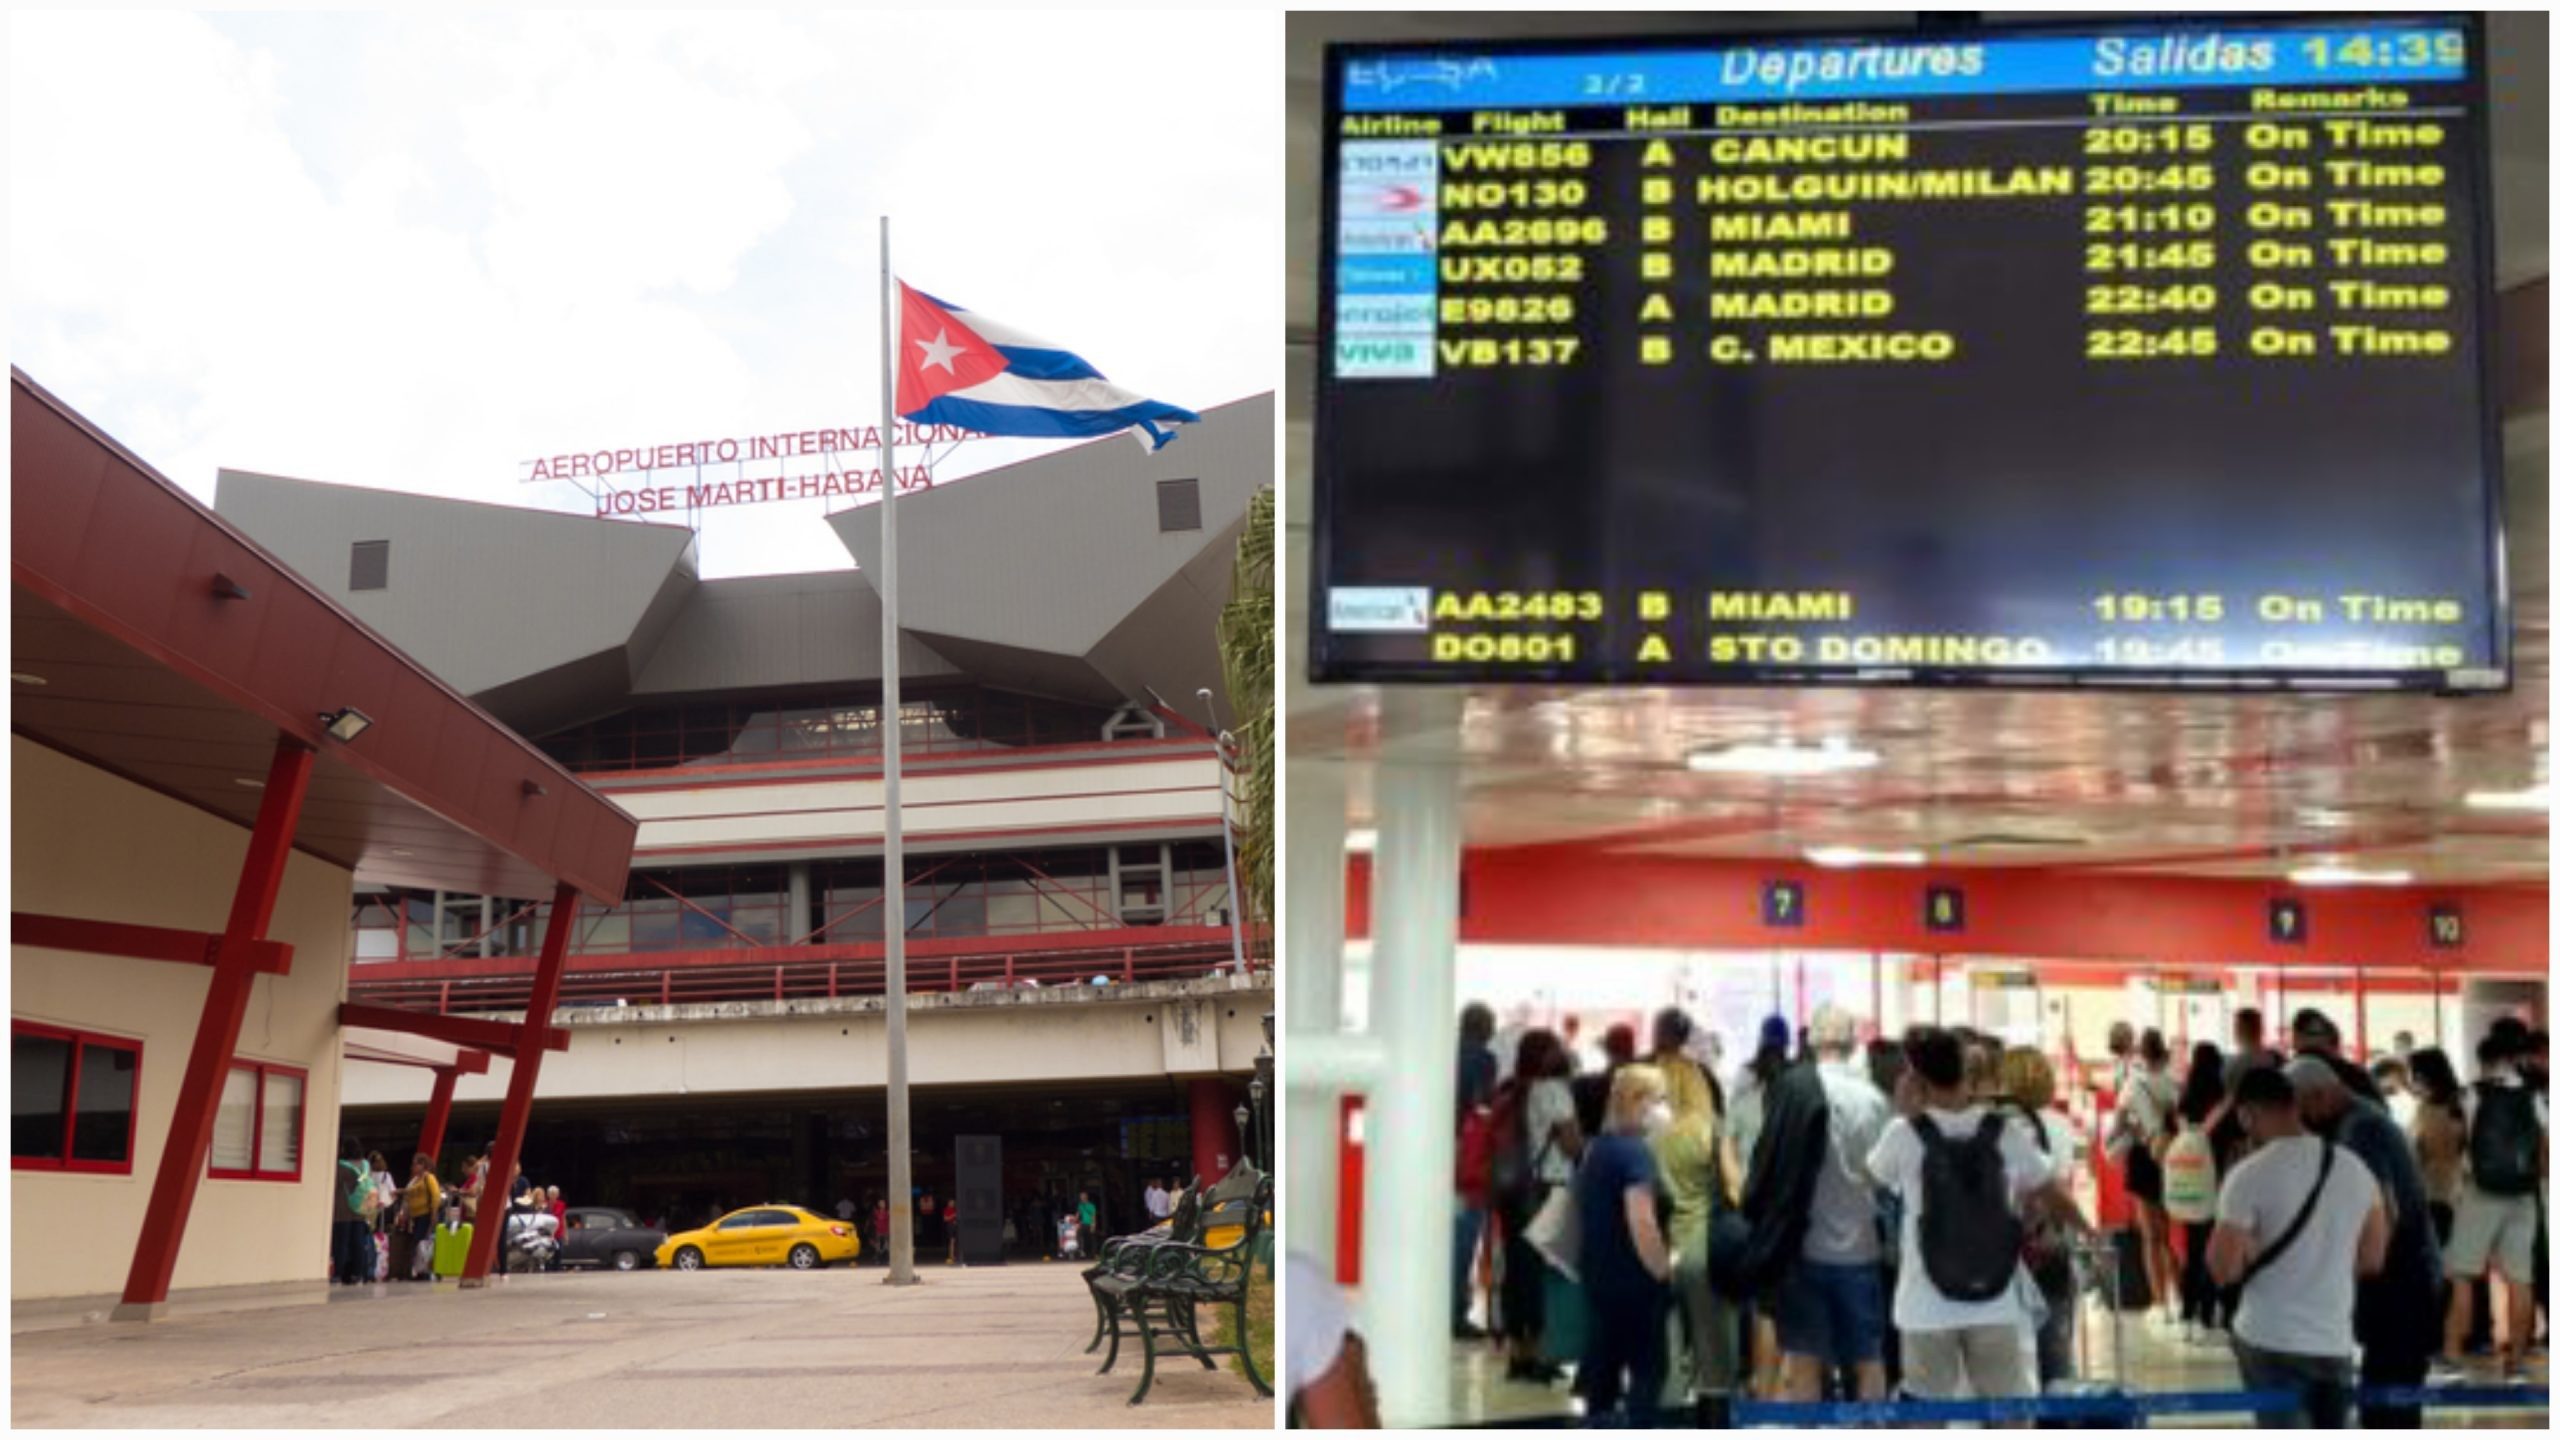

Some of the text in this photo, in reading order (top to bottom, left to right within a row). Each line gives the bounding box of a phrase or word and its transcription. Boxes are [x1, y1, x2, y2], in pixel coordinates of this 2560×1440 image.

[1720, 45, 1984, 91] Departures
[2093, 36, 2276, 77] Salidas
[1341, 88, 2409, 135] Airline Flight Hall Destination Time Remarks
[1642, 142, 1674, 166] A
[1711, 137, 1907, 163] CANCUN
[2087, 127, 2213, 153] 20:15
[2246, 123, 2309, 149] On
[2326, 120, 2444, 148] Time
[1442, 161, 2445, 209] NO130 B HOLGUIN/MILAN 20:45 On Time
[1642, 216, 1672, 243] B
[1712, 212, 1850, 240] MIAMI
[2087, 205, 2215, 233] 21:10
[2247, 202, 2312, 229] On
[2328, 201, 2446, 227] Time
[1441, 255, 1582, 282] UX052
[1642, 253, 1672, 279] B
[1712, 249, 1893, 277] MADRID
[2087, 242, 2216, 271] 21:45
[2248, 241, 2313, 268] On
[2330, 239, 2448, 266] Time
[1641, 293, 1673, 320] A
[1711, 290, 1893, 319] MADRID
[2088, 285, 2217, 313] 22:40
[2249, 283, 2313, 310] On
[2331, 281, 2450, 309] Time
[1438, 325, 2451, 366] VB137 B C. MEXICO 22:45 On Time
[531, 421, 995, 480] AEROPUERTO INTERNACION
[601, 463, 932, 515] JOSE MARTI-HABANA
[1435, 592, 1603, 620] AA2483
[1639, 592, 1669, 619] B
[1710, 592, 1850, 620] MIAMI
[2094, 595, 2224, 622] 19:15
[2258, 596, 2322, 623] On
[2340, 596, 2461, 622] Time
[1637, 635, 1670, 661] A
[1710, 635, 1802, 662] STO
[1820, 635, 2050, 665] DOMINGO
[1774, 888, 1791, 919] 7
[2433, 916, 2460, 942] 10
